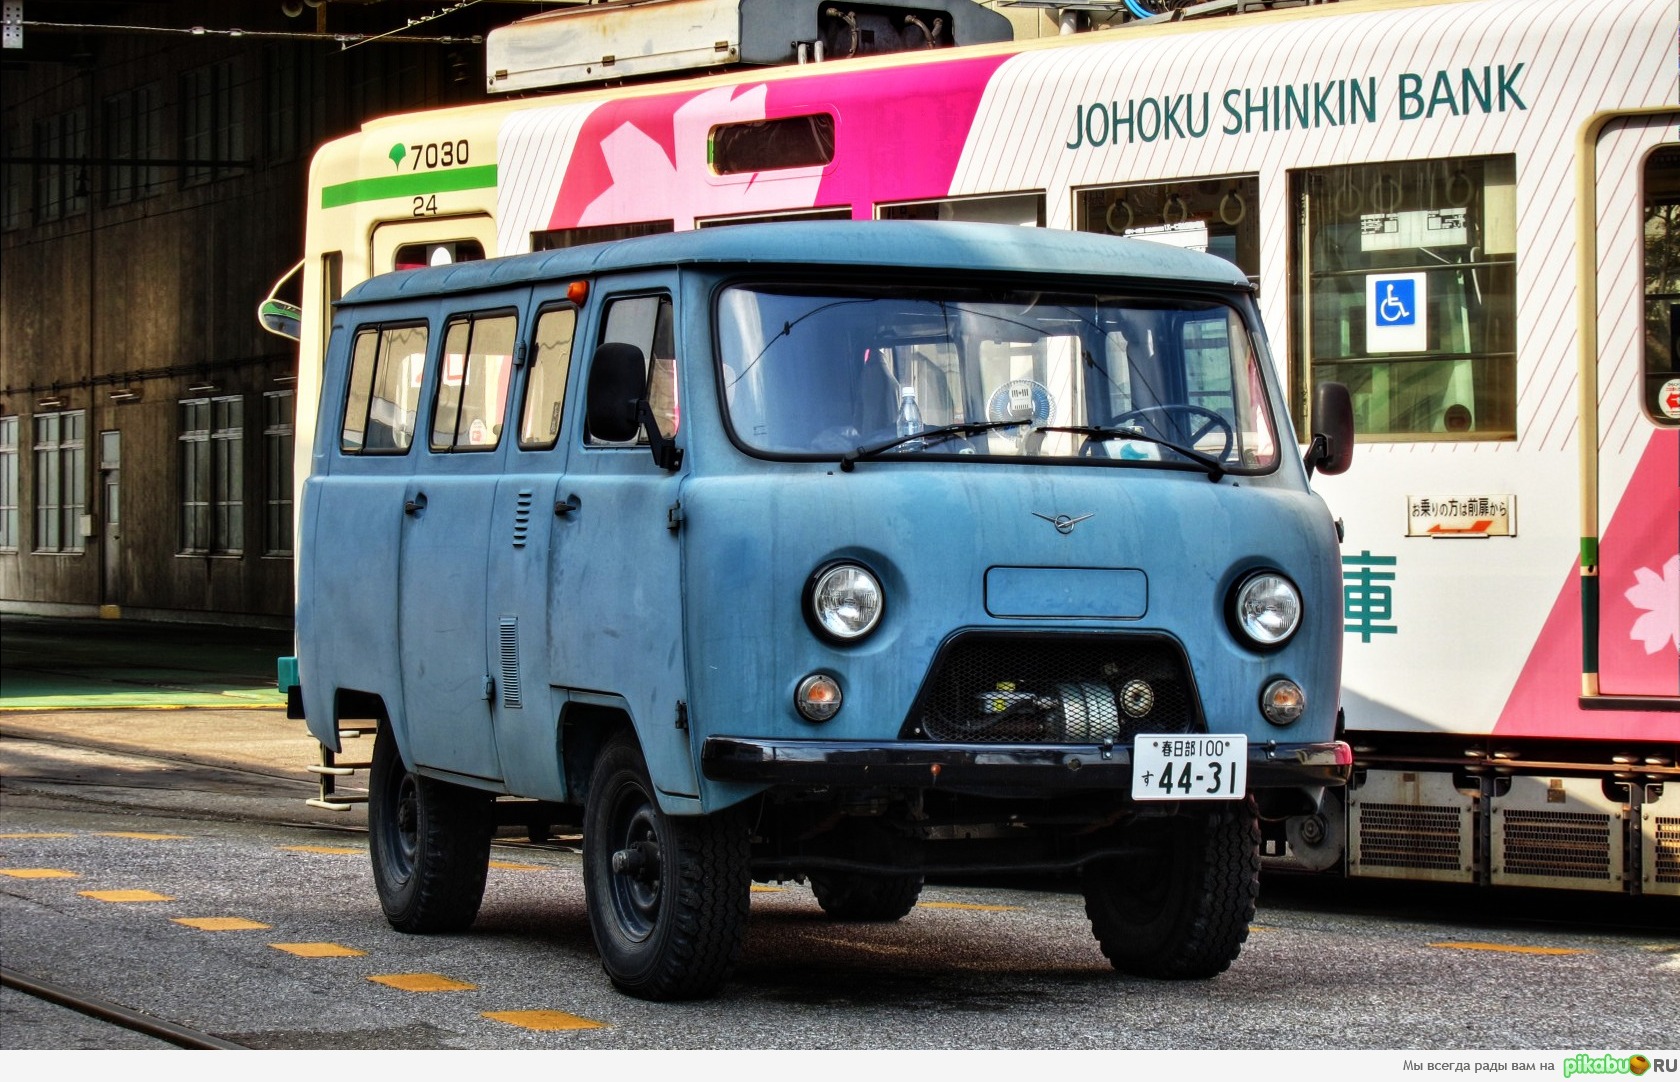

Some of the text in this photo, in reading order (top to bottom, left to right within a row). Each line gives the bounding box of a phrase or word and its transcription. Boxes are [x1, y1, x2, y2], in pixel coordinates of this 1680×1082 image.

[1066, 62, 1528, 150] JOHOKU SHINKIN BANK
[410, 139, 469, 171] 7030
[413, 194, 438, 217] 24
[1411, 497, 1508, 518] お乗りの方は前扉から
[1141, 761, 1237, 794] す 44-31
